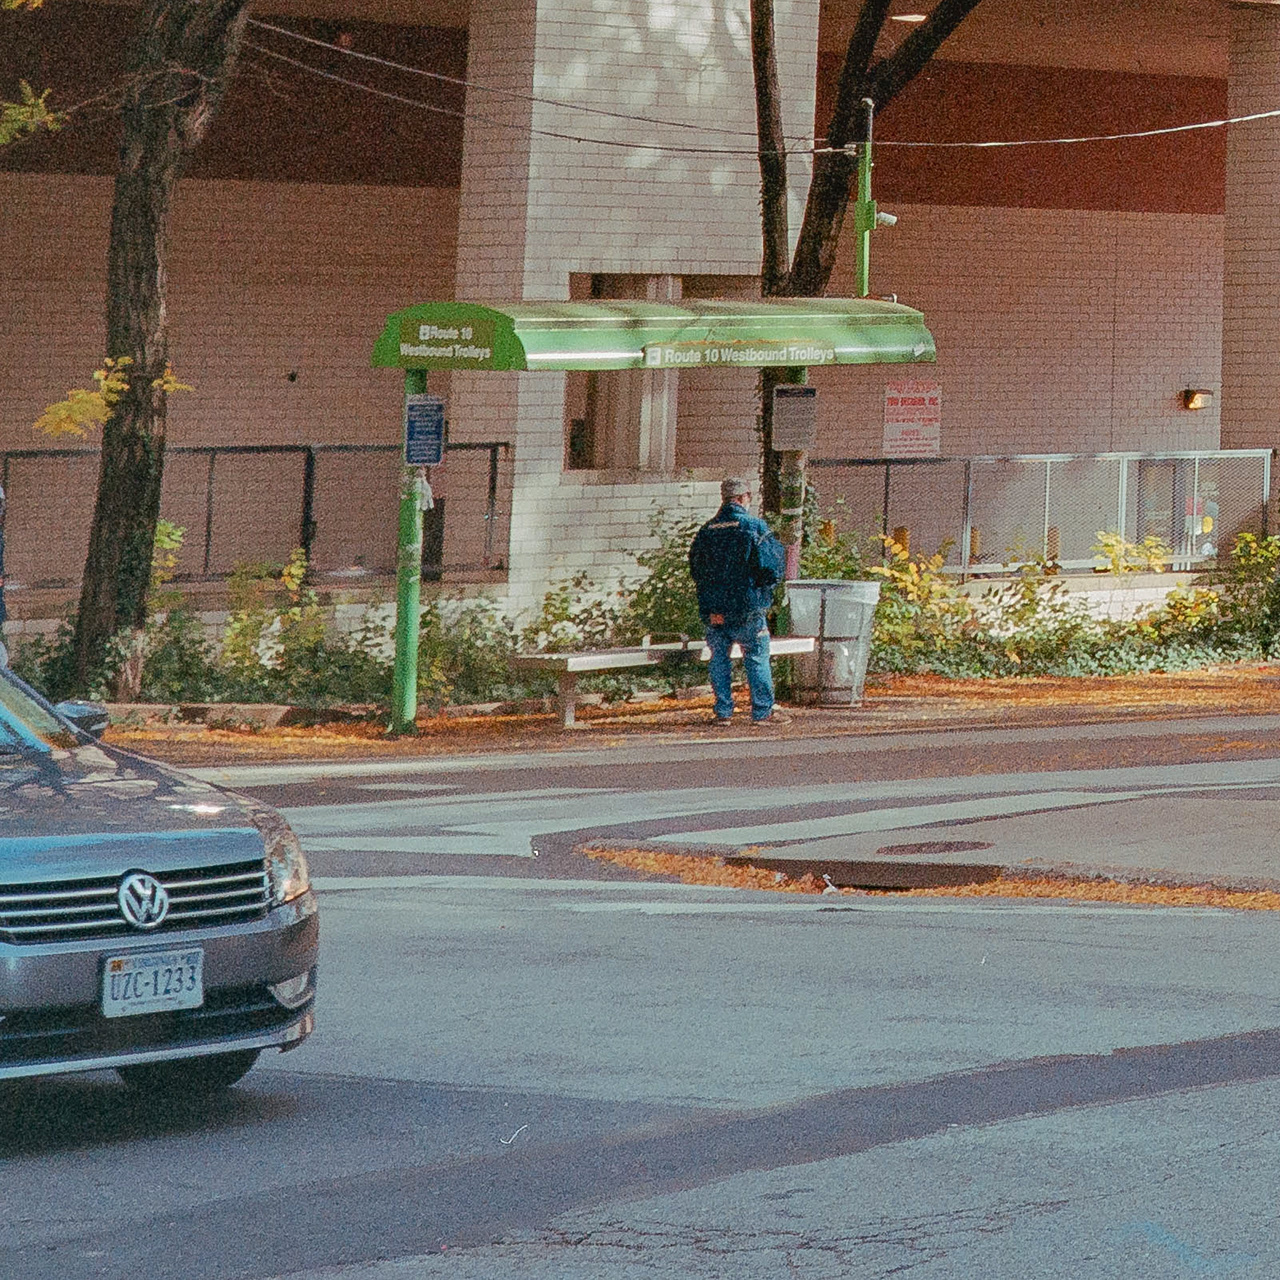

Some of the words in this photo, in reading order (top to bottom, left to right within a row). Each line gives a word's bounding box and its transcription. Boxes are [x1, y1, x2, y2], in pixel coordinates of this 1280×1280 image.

[430, 325, 459, 340] Route
[400, 342, 453, 357] Westbound
[453, 343, 491, 362] Trolleys
[664, 349, 701, 363] Route
[704, 348, 719, 362] 10
[720, 347, 787, 362] Westbound
[789, 346, 834, 362] Trolleys
[110, 965, 197, 1001] UZC-1233
